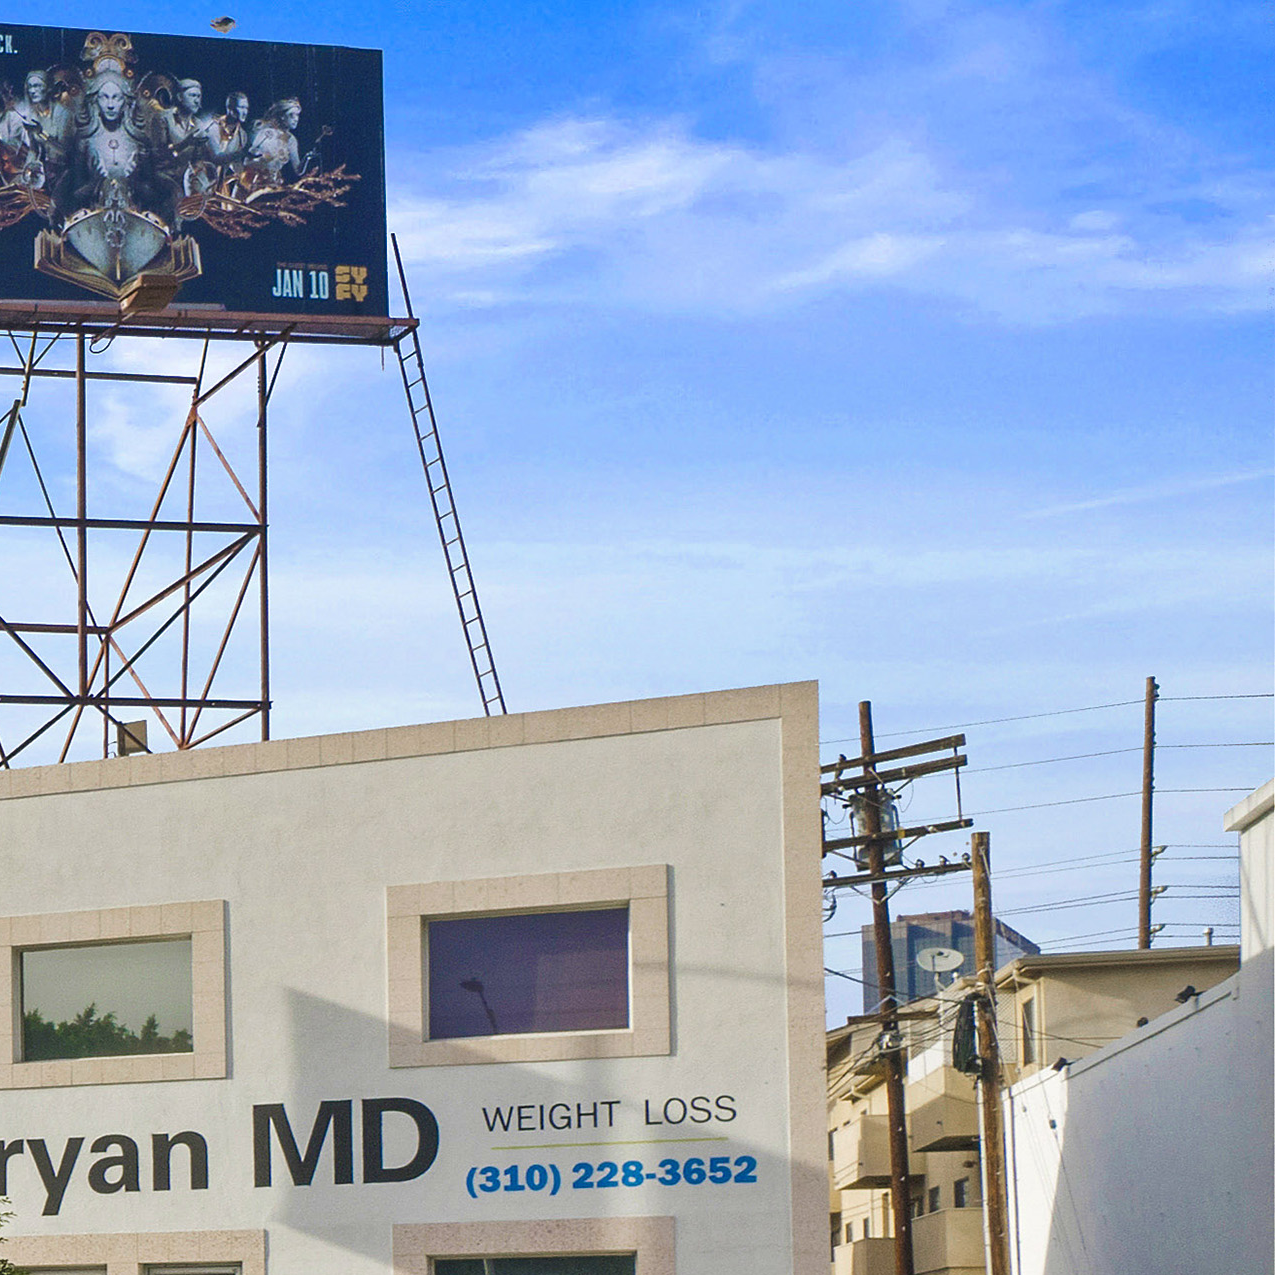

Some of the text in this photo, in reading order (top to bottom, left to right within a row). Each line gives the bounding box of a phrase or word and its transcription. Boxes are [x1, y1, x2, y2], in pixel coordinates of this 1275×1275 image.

[272, 269, 329, 299] JAN 10
[482, 1095, 737, 1132] WEIGHT LOSS
[252, 1097, 439, 1188] MD
[466, 1155, 757, 1198] (310) 228-3652
